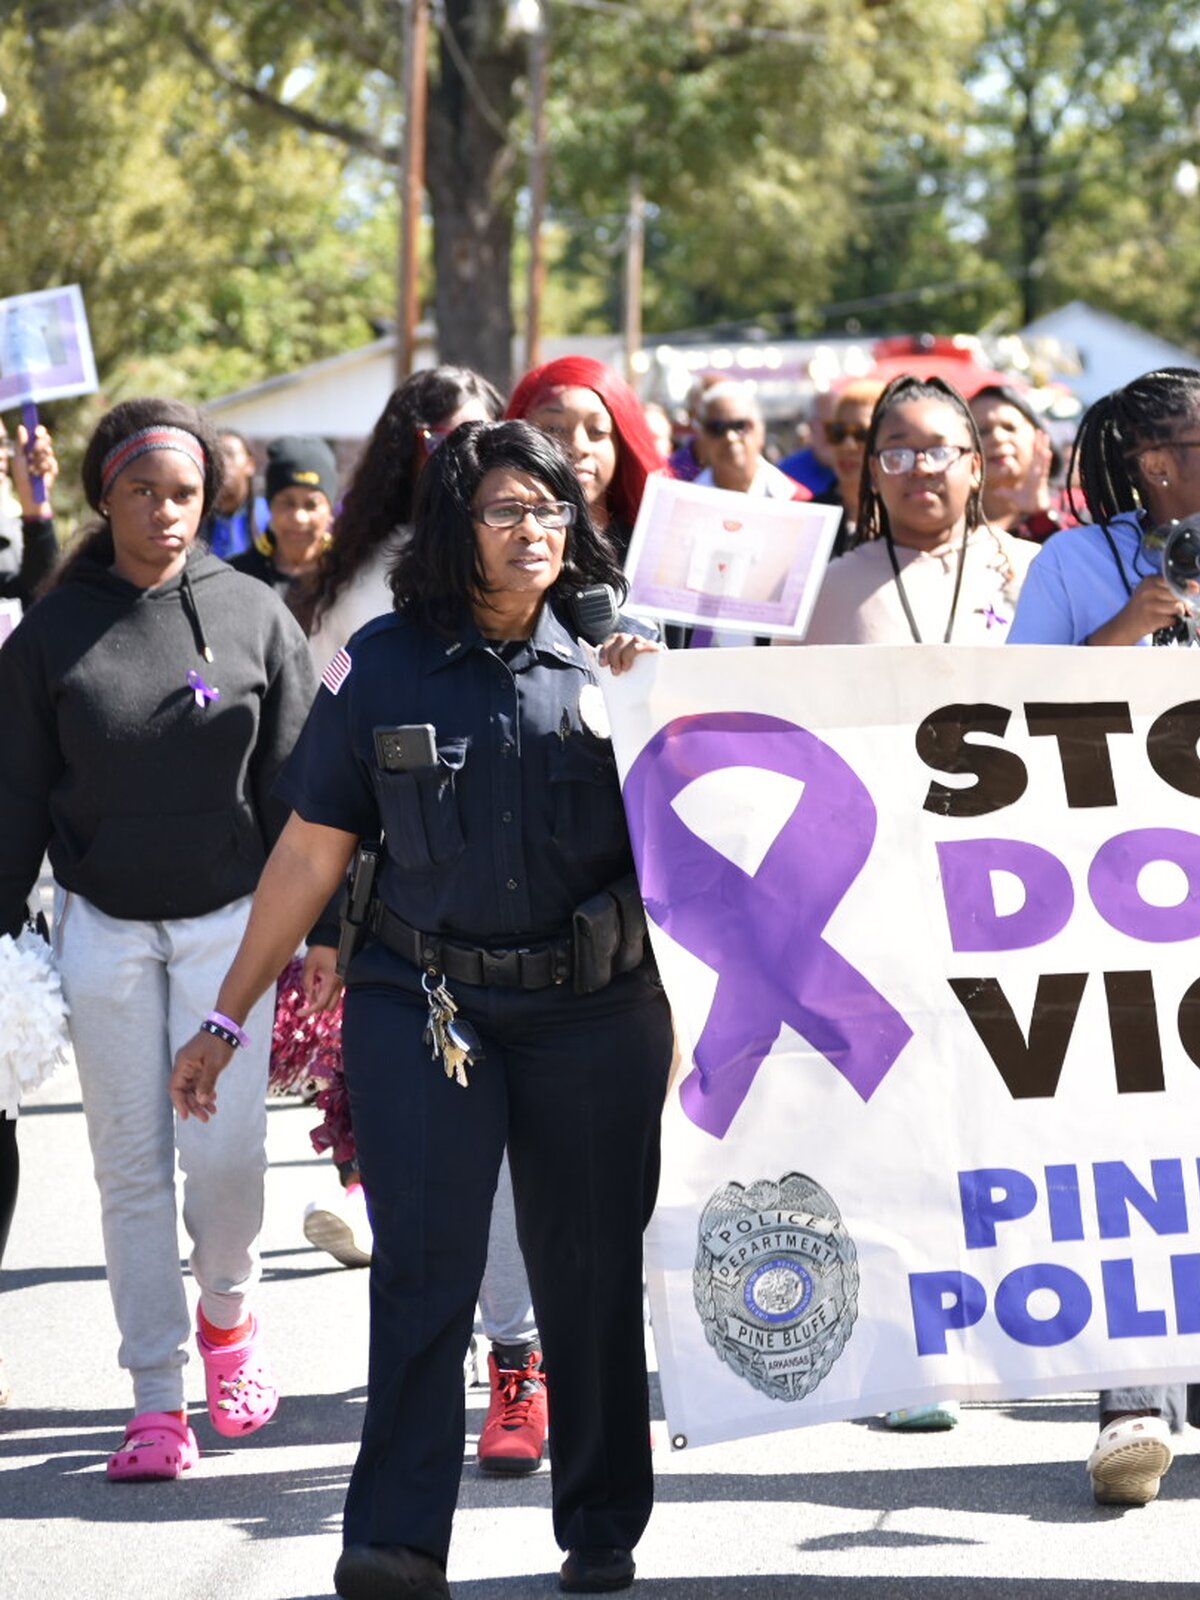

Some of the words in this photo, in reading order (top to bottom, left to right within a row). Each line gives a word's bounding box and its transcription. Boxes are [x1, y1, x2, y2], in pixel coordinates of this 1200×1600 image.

[719, 1211, 818, 1244] POLICE
[718, 1233, 831, 1278] DEPARTMENT
[738, 1325, 775, 1349] PINE
[783, 1310, 827, 1347] BLUFF
[768, 1354, 810, 1370] ARKANSAS
